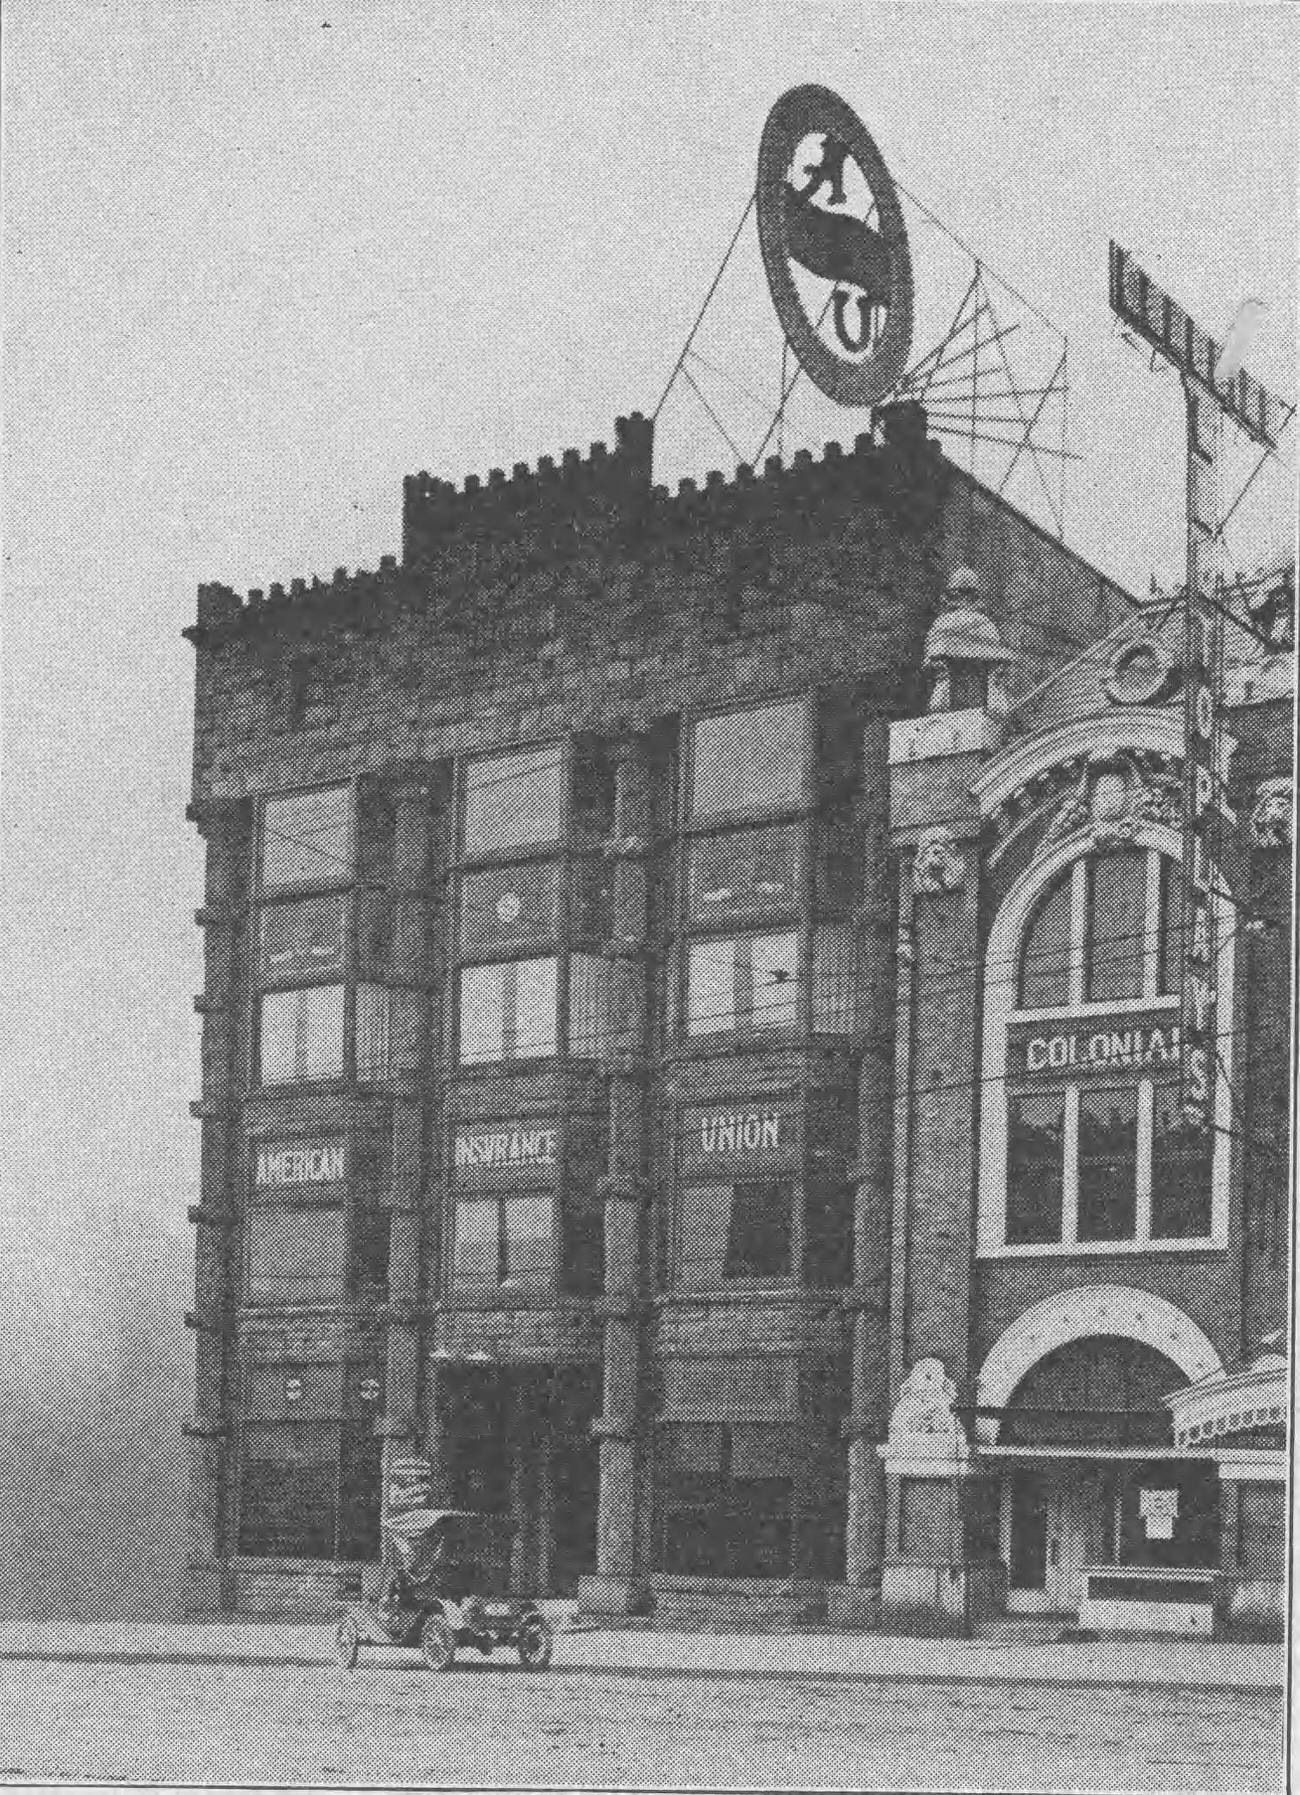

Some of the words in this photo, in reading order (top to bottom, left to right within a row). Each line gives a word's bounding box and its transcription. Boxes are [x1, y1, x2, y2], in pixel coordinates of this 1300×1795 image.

[255, 1147, 344, 1185] AMERICAN
[454, 1130, 557, 1166] INSURANCE
[701, 1112, 779, 1152] UNION
